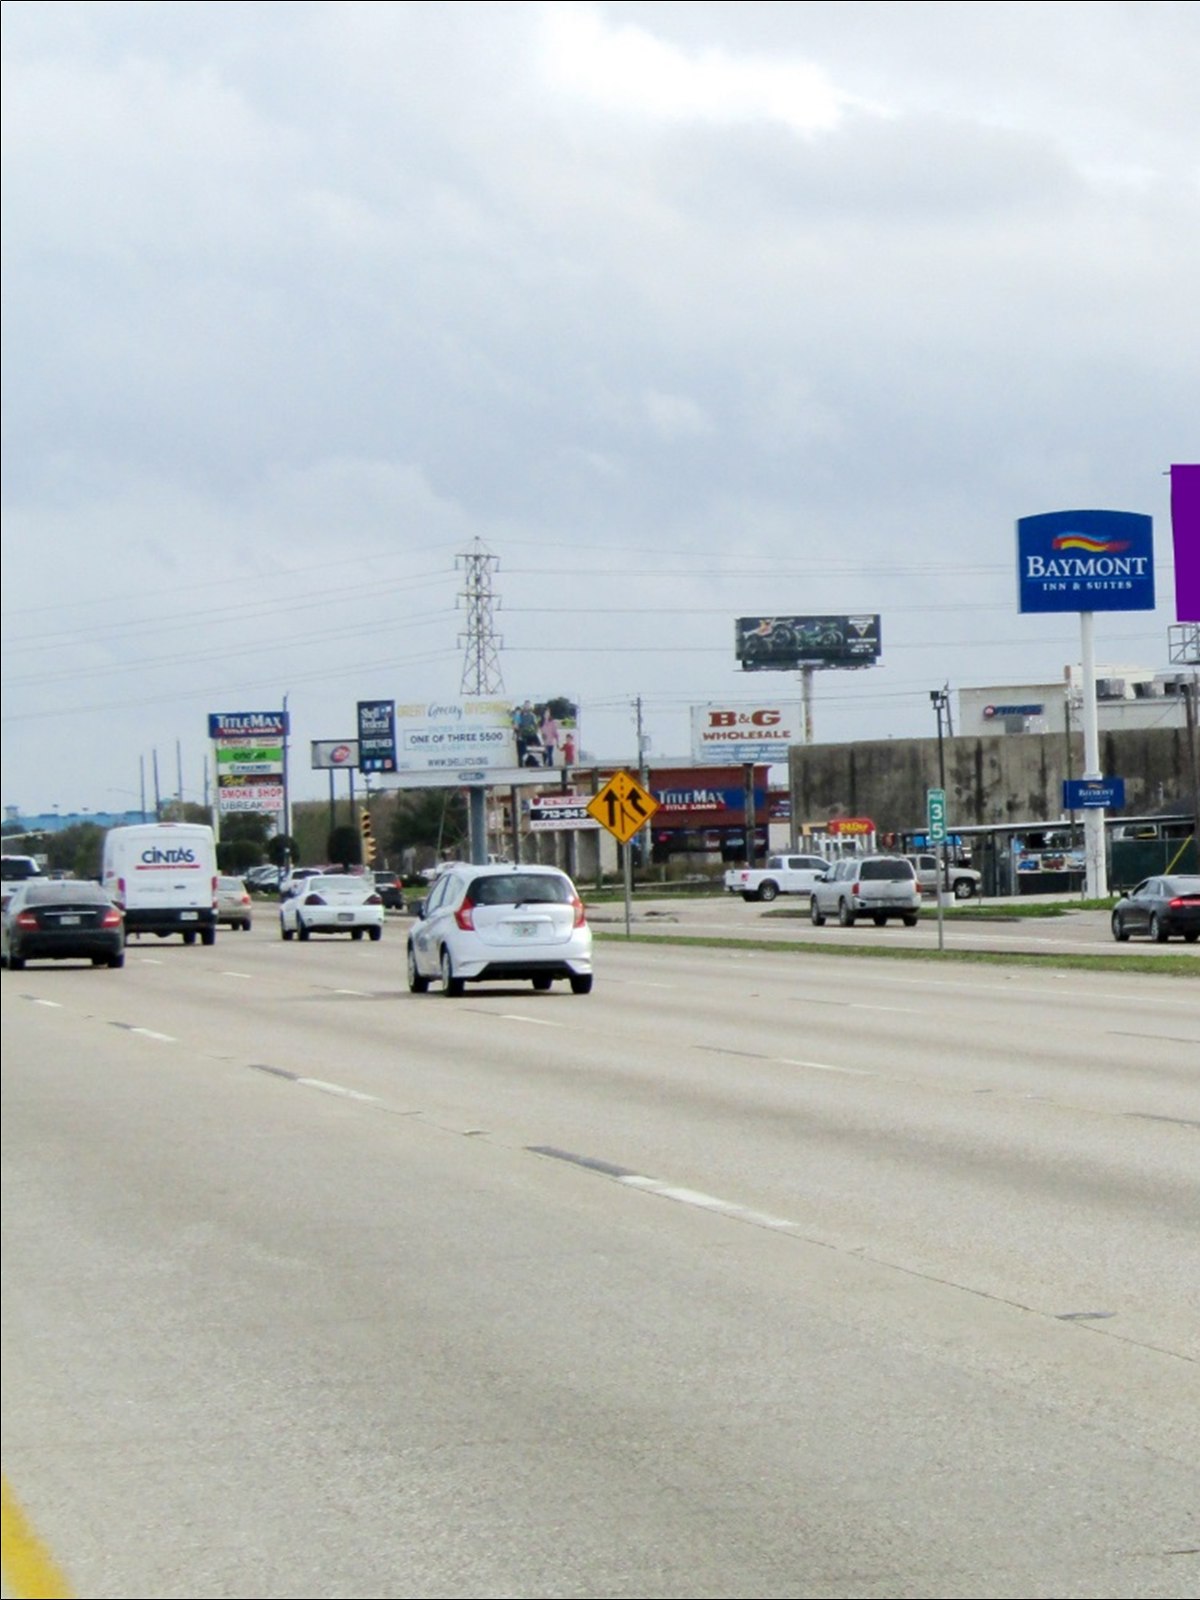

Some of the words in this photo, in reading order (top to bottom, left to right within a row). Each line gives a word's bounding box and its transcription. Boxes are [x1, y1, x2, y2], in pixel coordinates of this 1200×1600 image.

[1026, 555, 1148, 578] BAYMONT
[1043, 582, 1067, 591] INN
[1072, 582, 1081, 590] &
[1086, 581, 1133, 590] SUITES
[708, 709, 781, 727] B&G
[410, 735, 430, 744] ONE
[431, 735, 446, 744] OF
[448, 734, 478, 743] THREE
[703, 730, 792, 740] WHOLESALE
[221, 789, 254, 799] SMOKE
[257, 788, 283, 798] SHOP
[665, 803, 688, 811] TITLE
[931, 803, 943, 820] 3
[932, 822, 944, 839] 5
[141, 846, 196, 864] CINTAS
